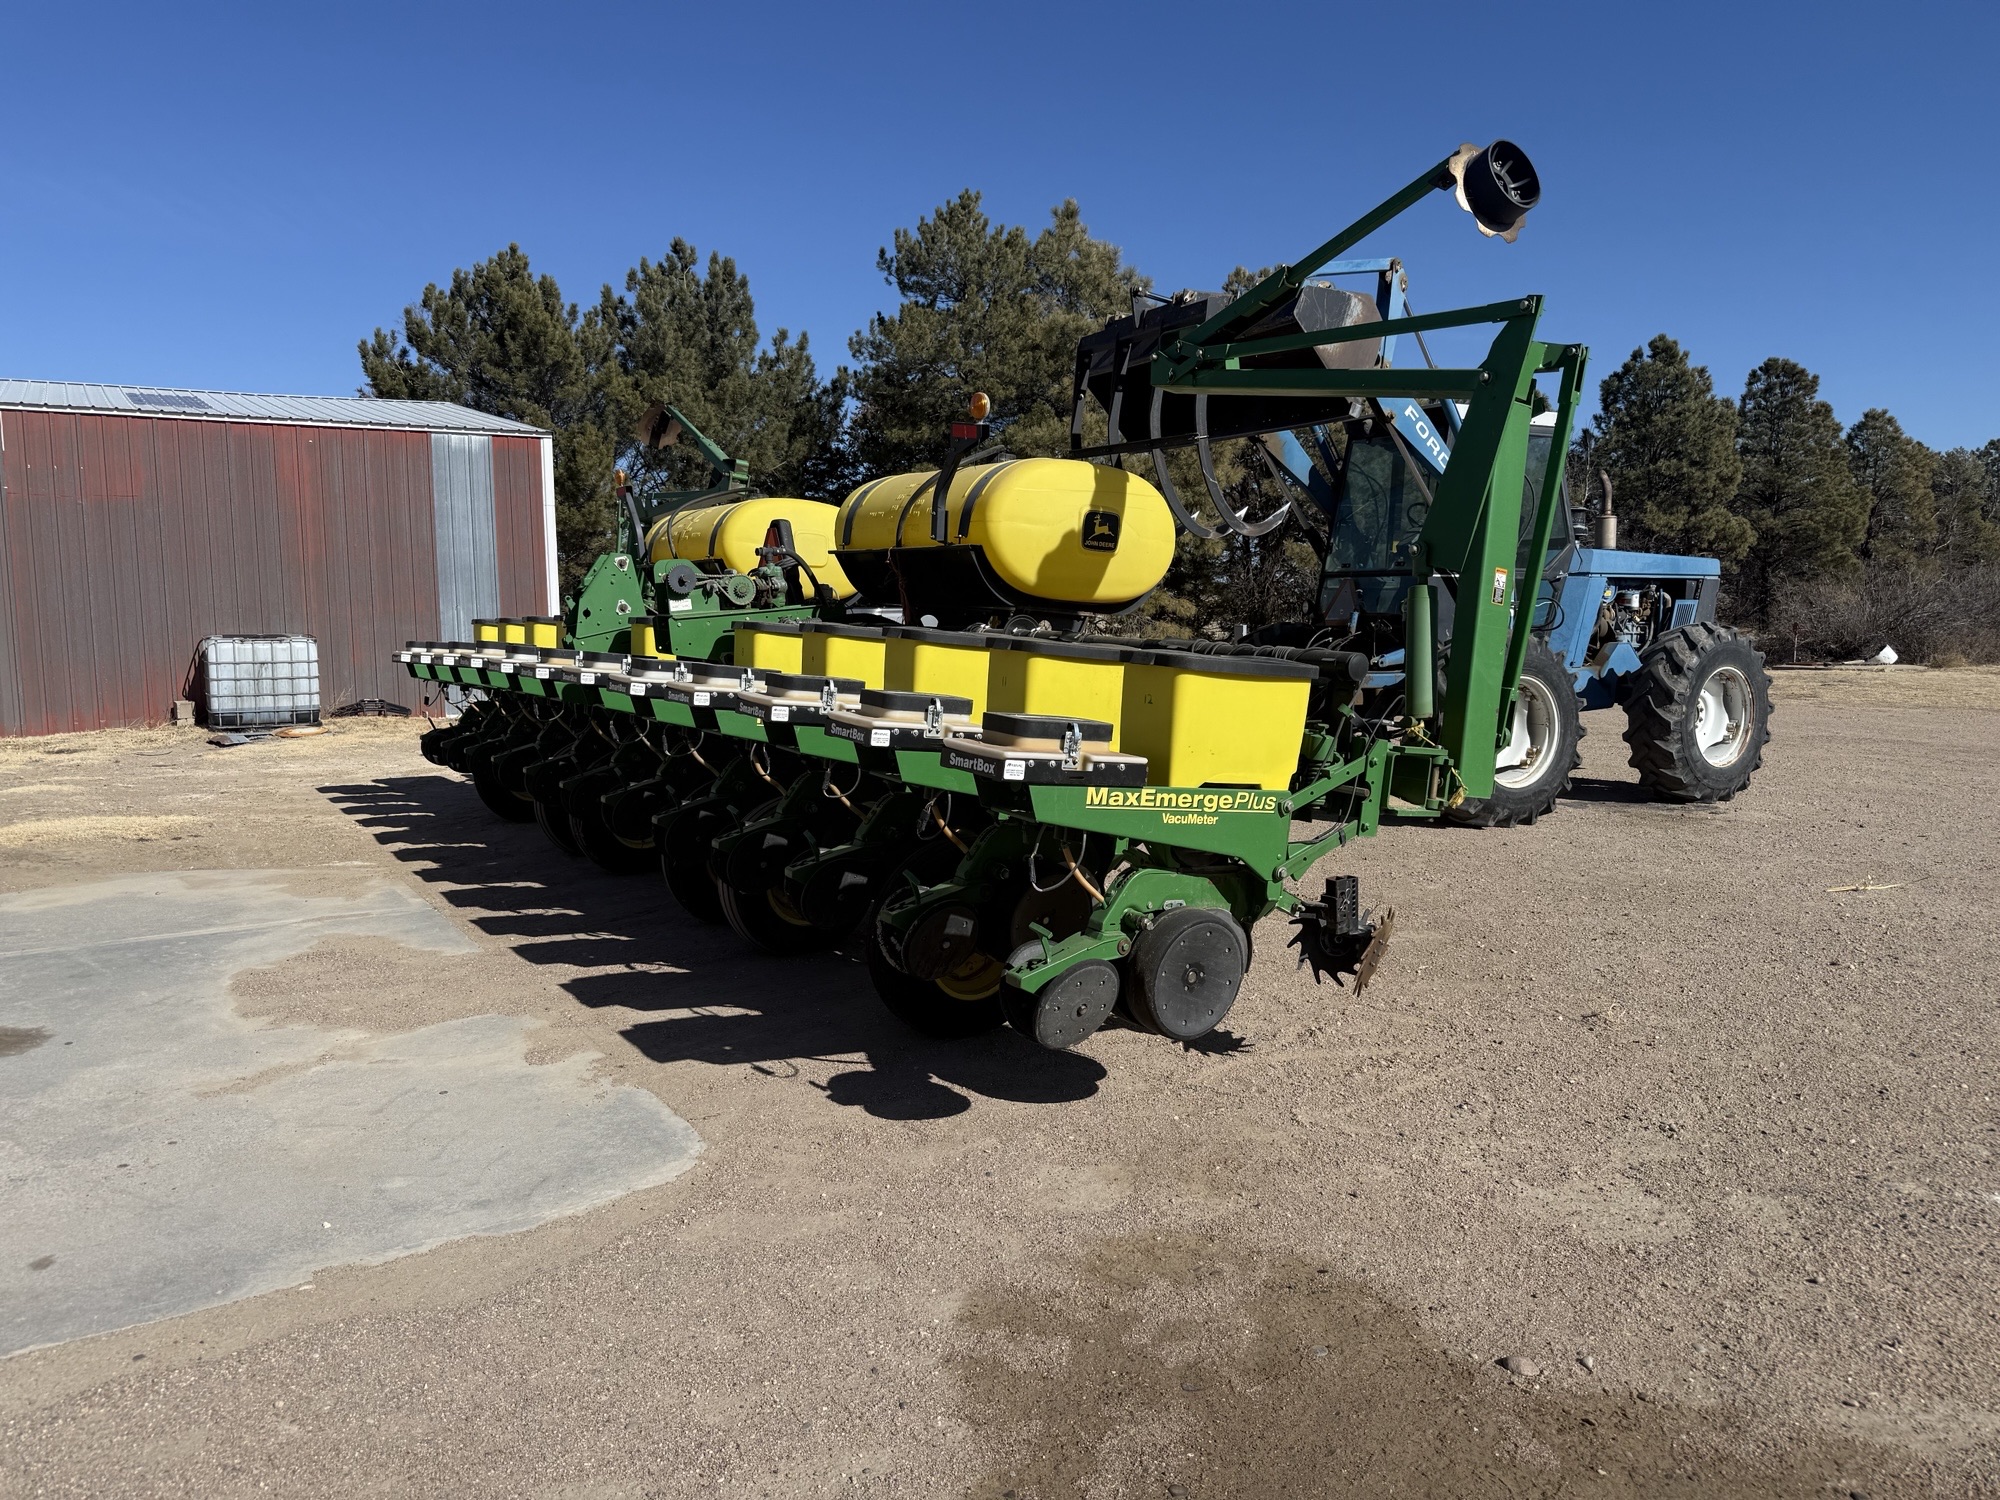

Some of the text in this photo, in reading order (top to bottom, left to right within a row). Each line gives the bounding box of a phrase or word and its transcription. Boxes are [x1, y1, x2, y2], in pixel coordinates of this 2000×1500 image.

[1404, 405, 1450, 469] FORD
[1099, 541, 1115, 549] DEERE
[1144, 693, 1153, 705] 12
[739, 702, 765, 718] SmartBox
[830, 722, 865, 742] SmartBox
[949, 752, 996, 775] SmartBox
[1162, 812, 1219, 825] VacuMeter
